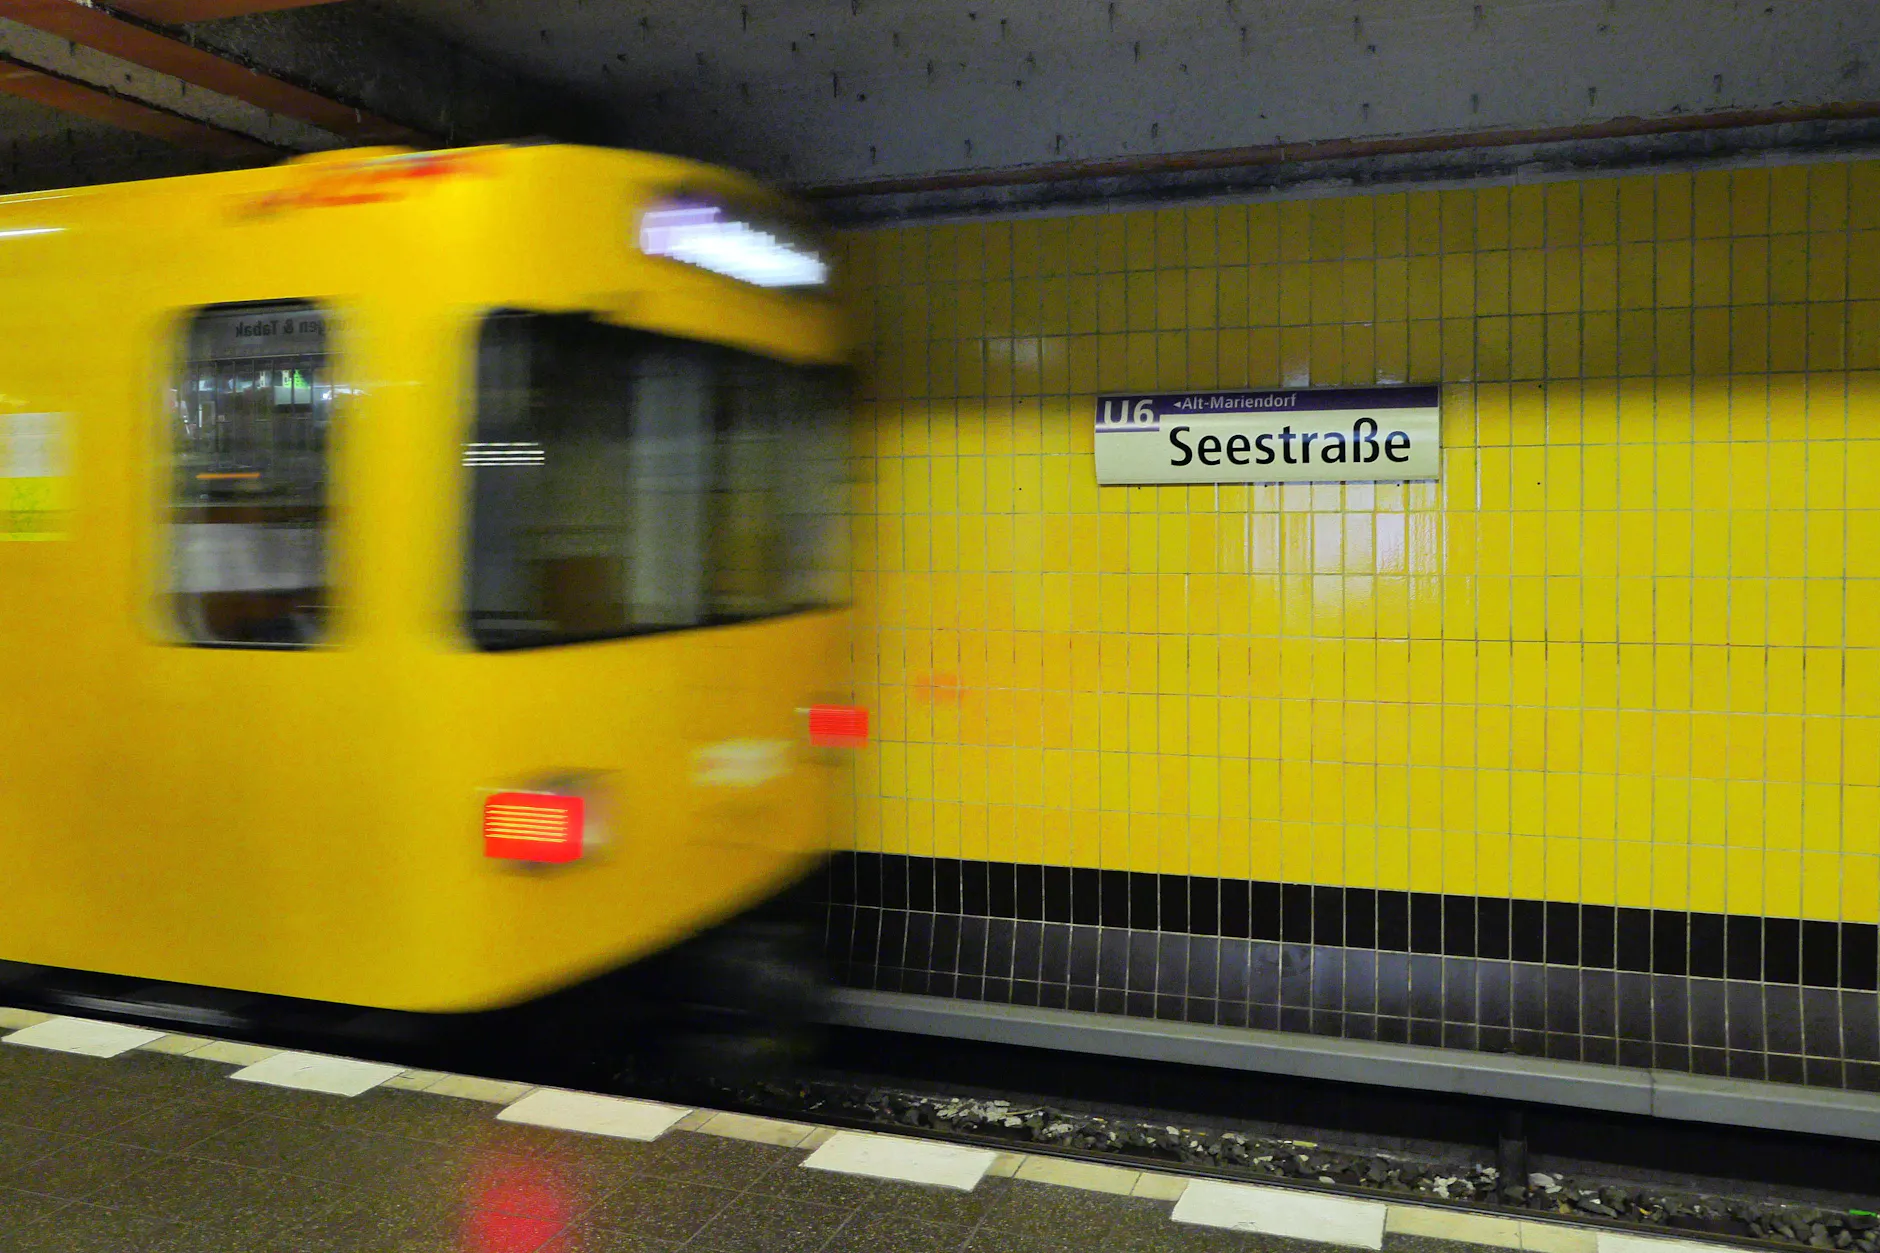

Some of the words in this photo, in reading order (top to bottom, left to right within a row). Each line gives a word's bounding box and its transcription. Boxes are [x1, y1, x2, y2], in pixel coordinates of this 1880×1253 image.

[1103, 399, 1155, 427] U6
[1181, 393, 1297, 410] Alt-Mariendorf
[1169, 417, 1411, 467] Seestraße
